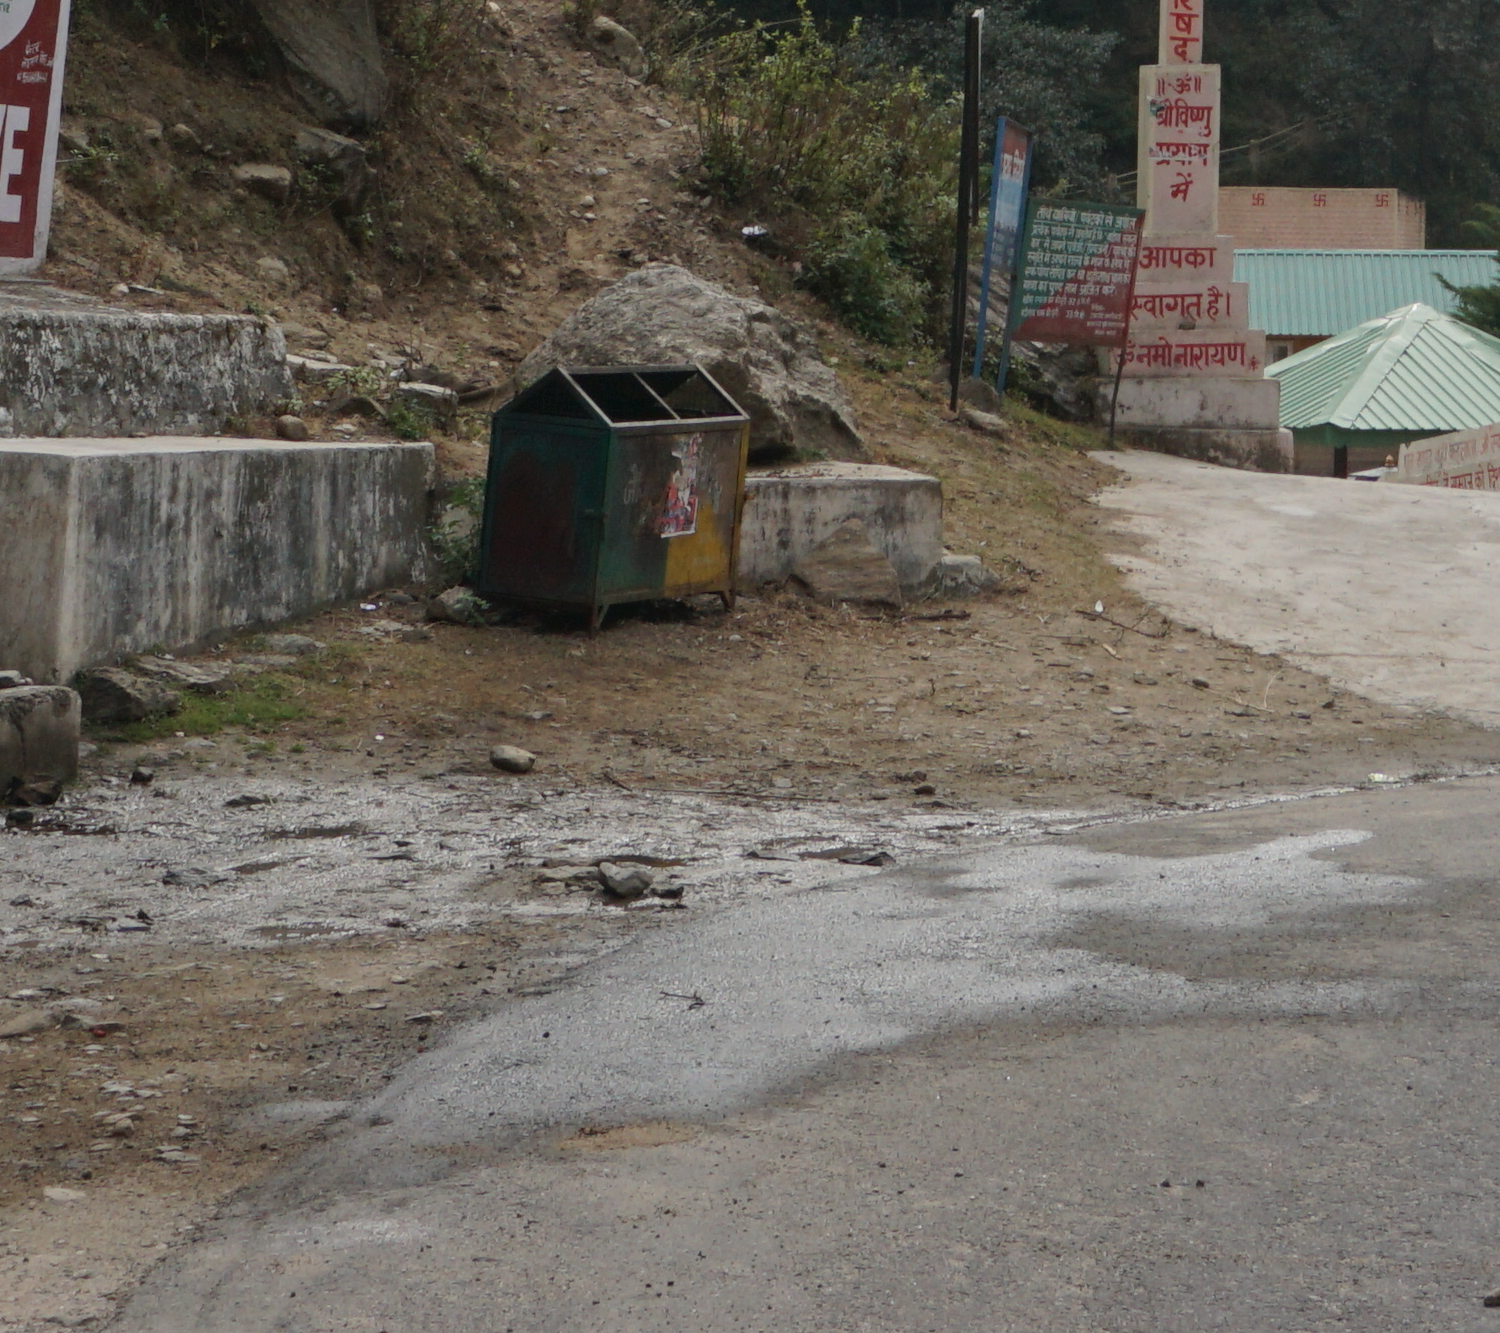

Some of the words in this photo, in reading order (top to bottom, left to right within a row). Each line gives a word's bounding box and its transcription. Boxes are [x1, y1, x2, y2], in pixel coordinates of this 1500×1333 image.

[1174, 98, 1213, 138] विष्णु
[1170, 172, 1193, 203] में
[1139, 245, 1217, 270] आपका
[1130, 293, 1203, 322] स्वागत
[1137, 335, 1173, 370] नमो
[1174, 341, 1247, 371] नारायण
